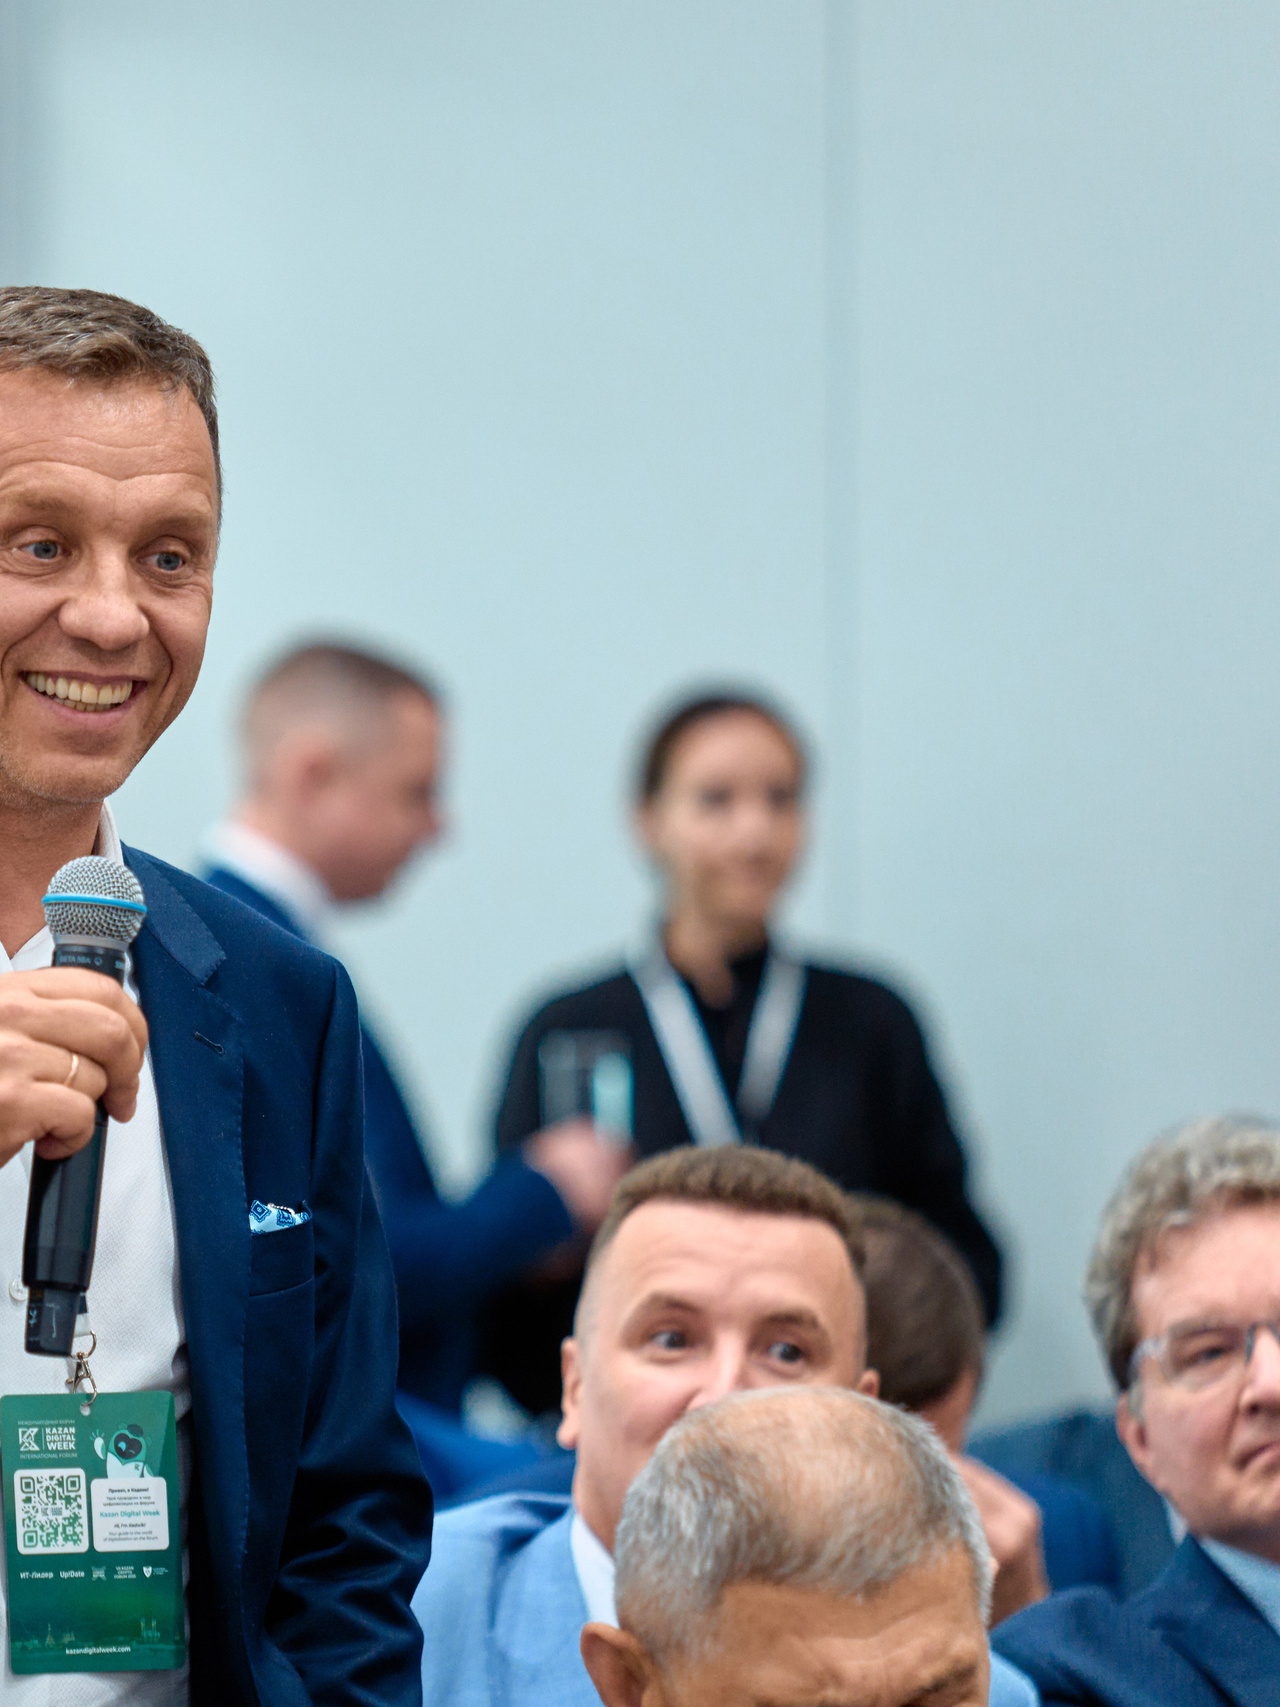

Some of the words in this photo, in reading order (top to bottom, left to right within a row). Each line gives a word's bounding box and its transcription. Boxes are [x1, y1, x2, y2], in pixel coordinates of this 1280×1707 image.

[46, 1442, 76, 1450] WEEK
[20, 1571, 54, 1579] ИТ-Лидер
[60, 1570, 85, 1579] Up!Date
[66, 1646, 131, 1655] kazandigitalweek.com
